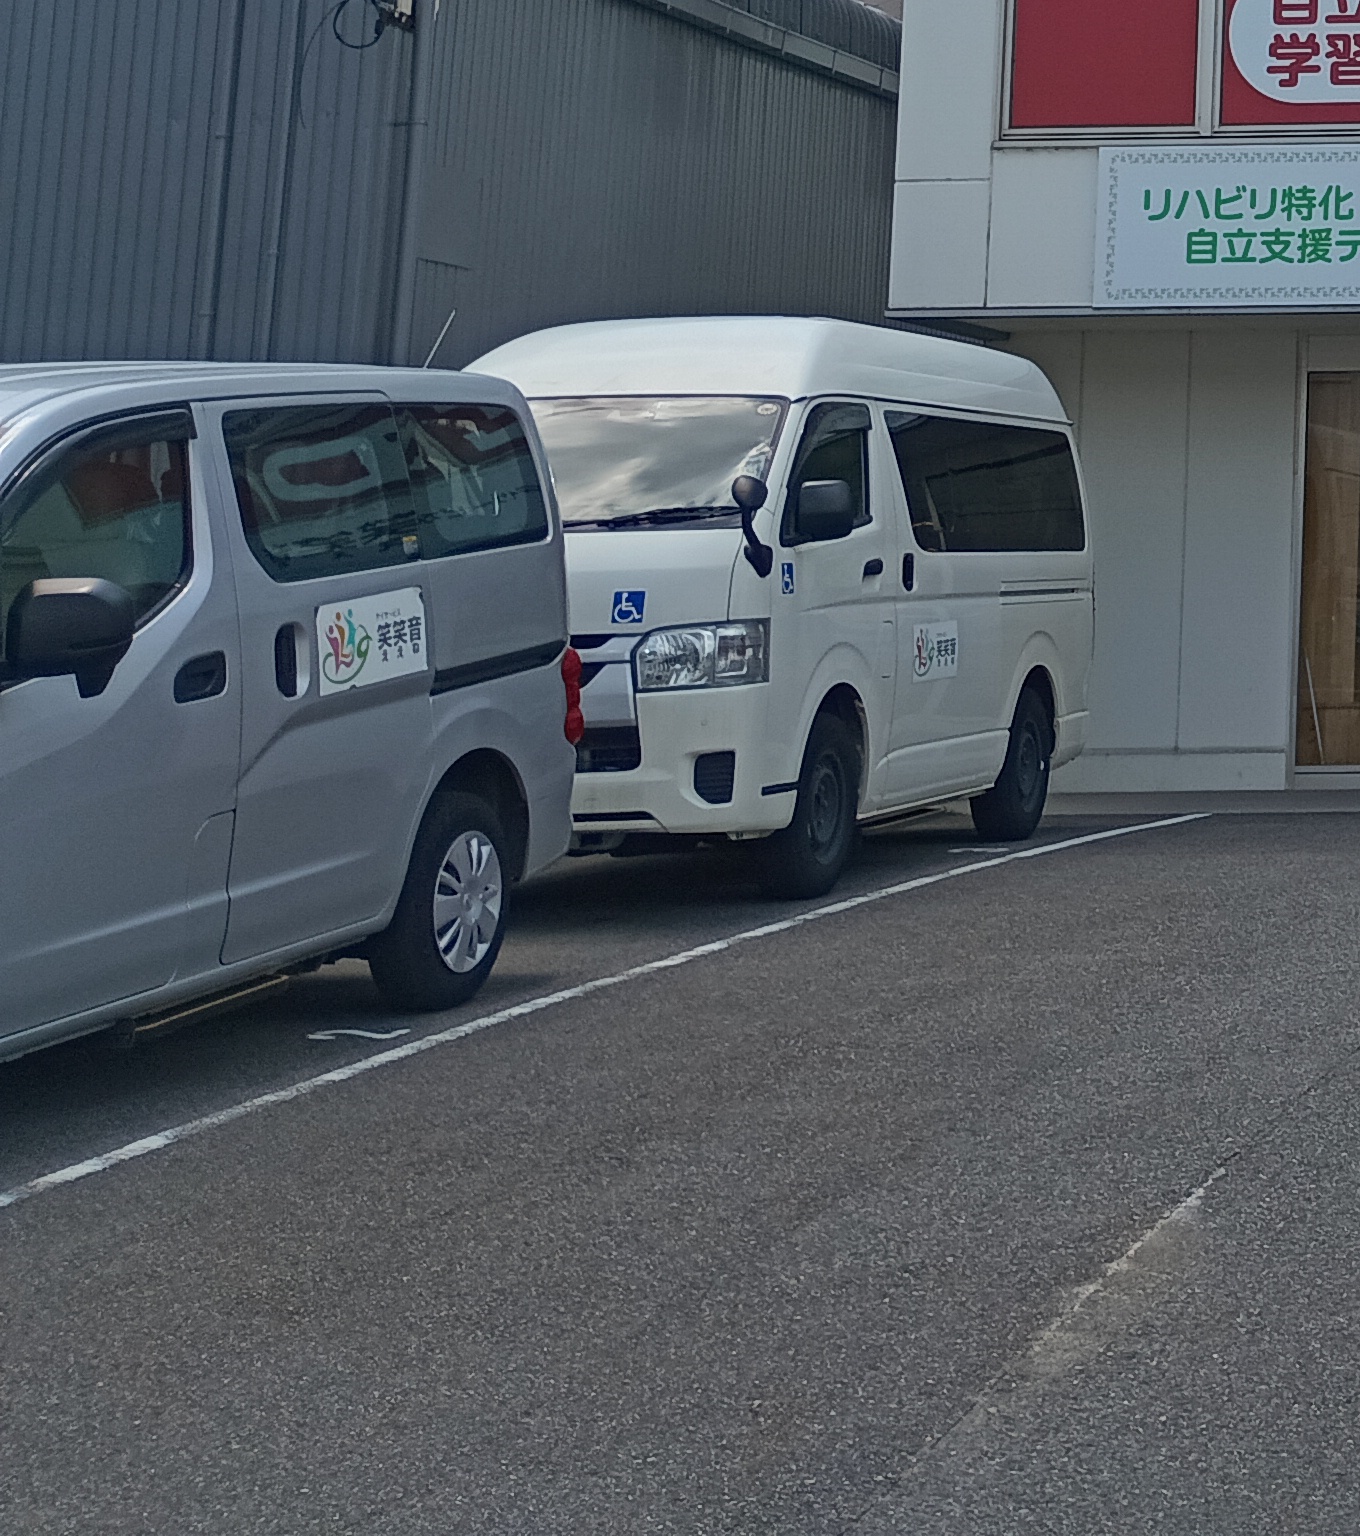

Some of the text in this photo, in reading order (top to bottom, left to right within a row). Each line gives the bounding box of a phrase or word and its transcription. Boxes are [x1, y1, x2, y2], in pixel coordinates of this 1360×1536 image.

[1143, 185, 1354, 222] リハビリ特化
